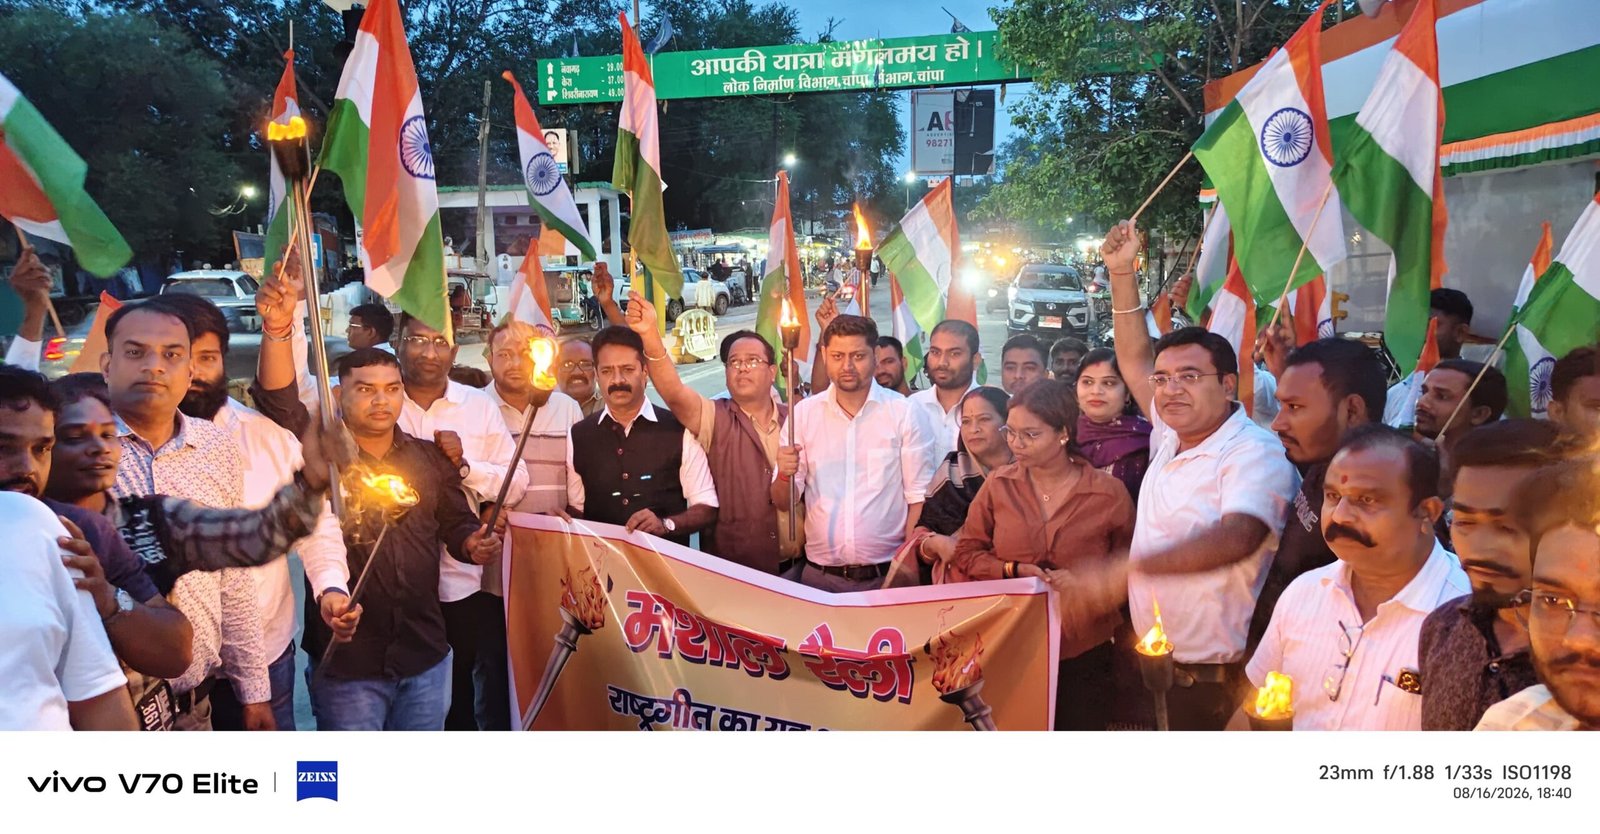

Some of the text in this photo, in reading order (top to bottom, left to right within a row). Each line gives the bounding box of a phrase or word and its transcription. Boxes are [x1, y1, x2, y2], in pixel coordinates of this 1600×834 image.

[691, 50, 766, 76] आपकी
[773, 52, 824, 69] यात्रा
[944, 36, 970, 62] हो
[723, 78, 750, 93] लोक
[753, 75, 794, 93] निर्माण
[623, 590, 916, 705] मशाल रैली
